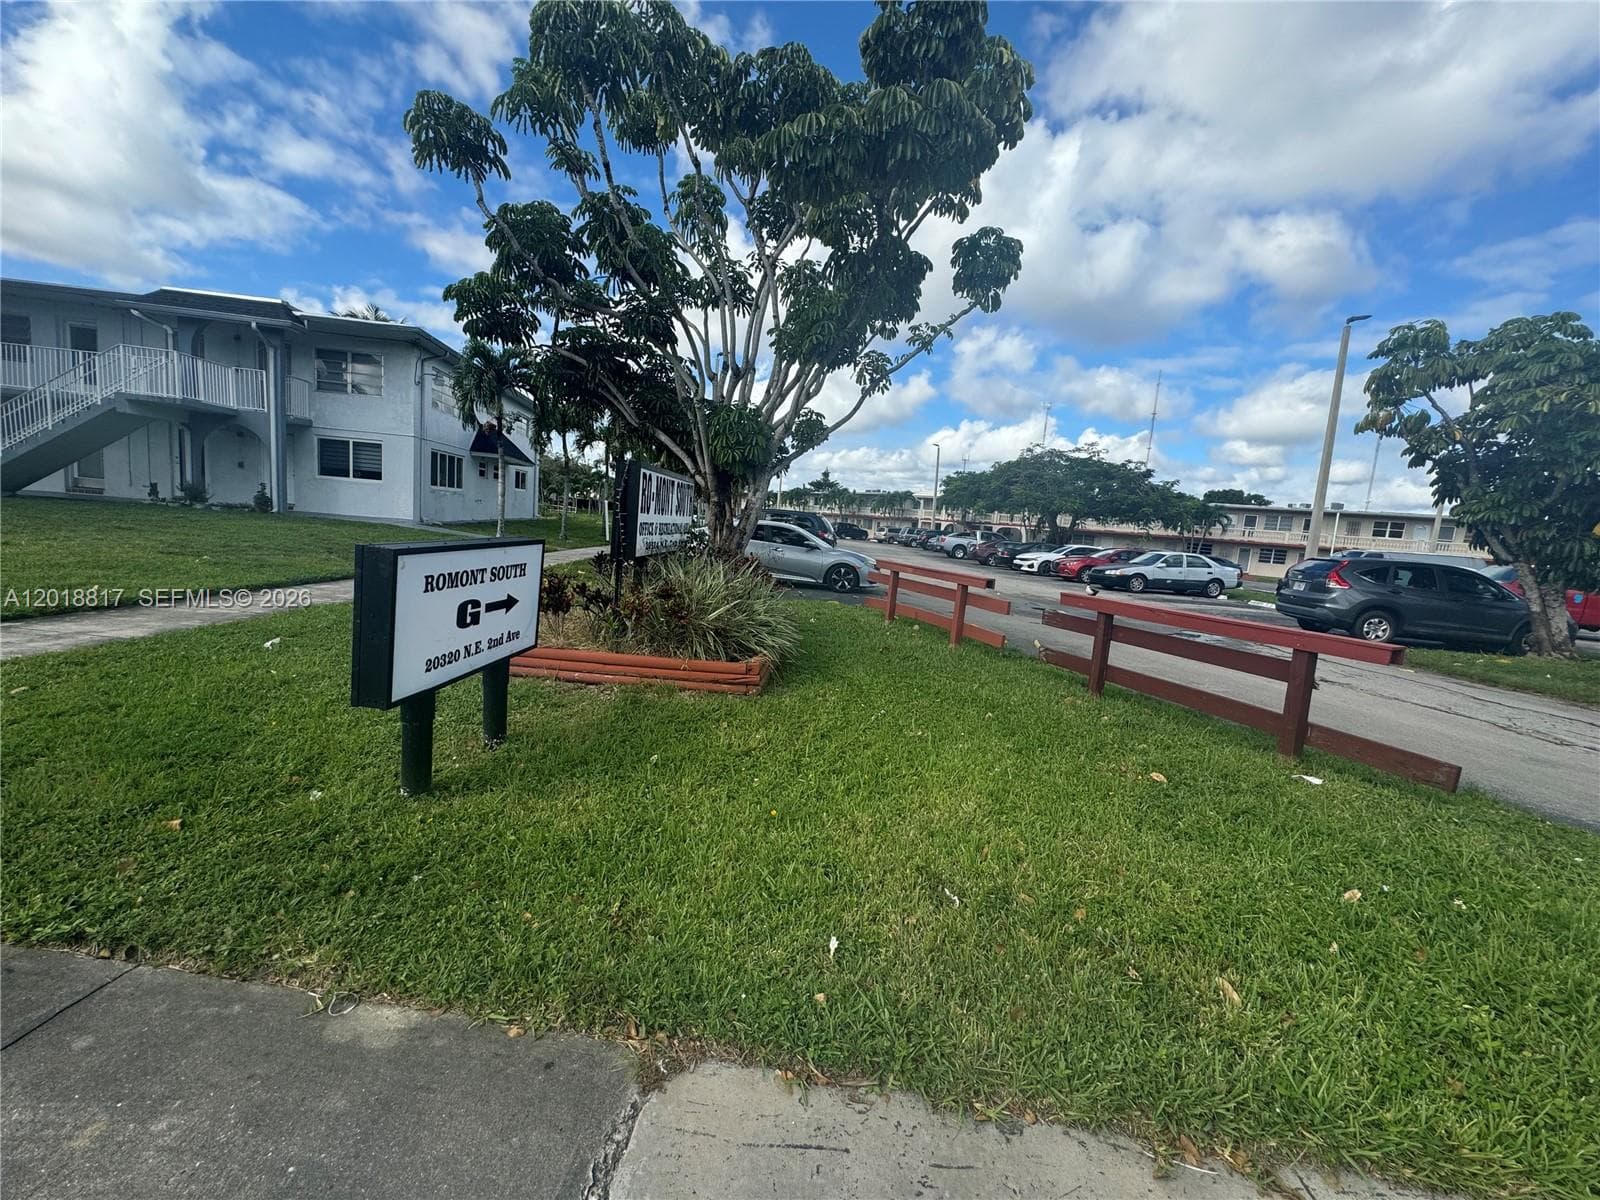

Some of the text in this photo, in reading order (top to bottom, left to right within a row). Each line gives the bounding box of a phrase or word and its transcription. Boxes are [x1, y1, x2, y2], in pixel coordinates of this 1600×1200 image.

[423, 563, 527, 593] ROMONT SOUTH
[456, 598, 482, 629] G
[424, 629, 521, 673] 20320 N.E. 2nd Ave
